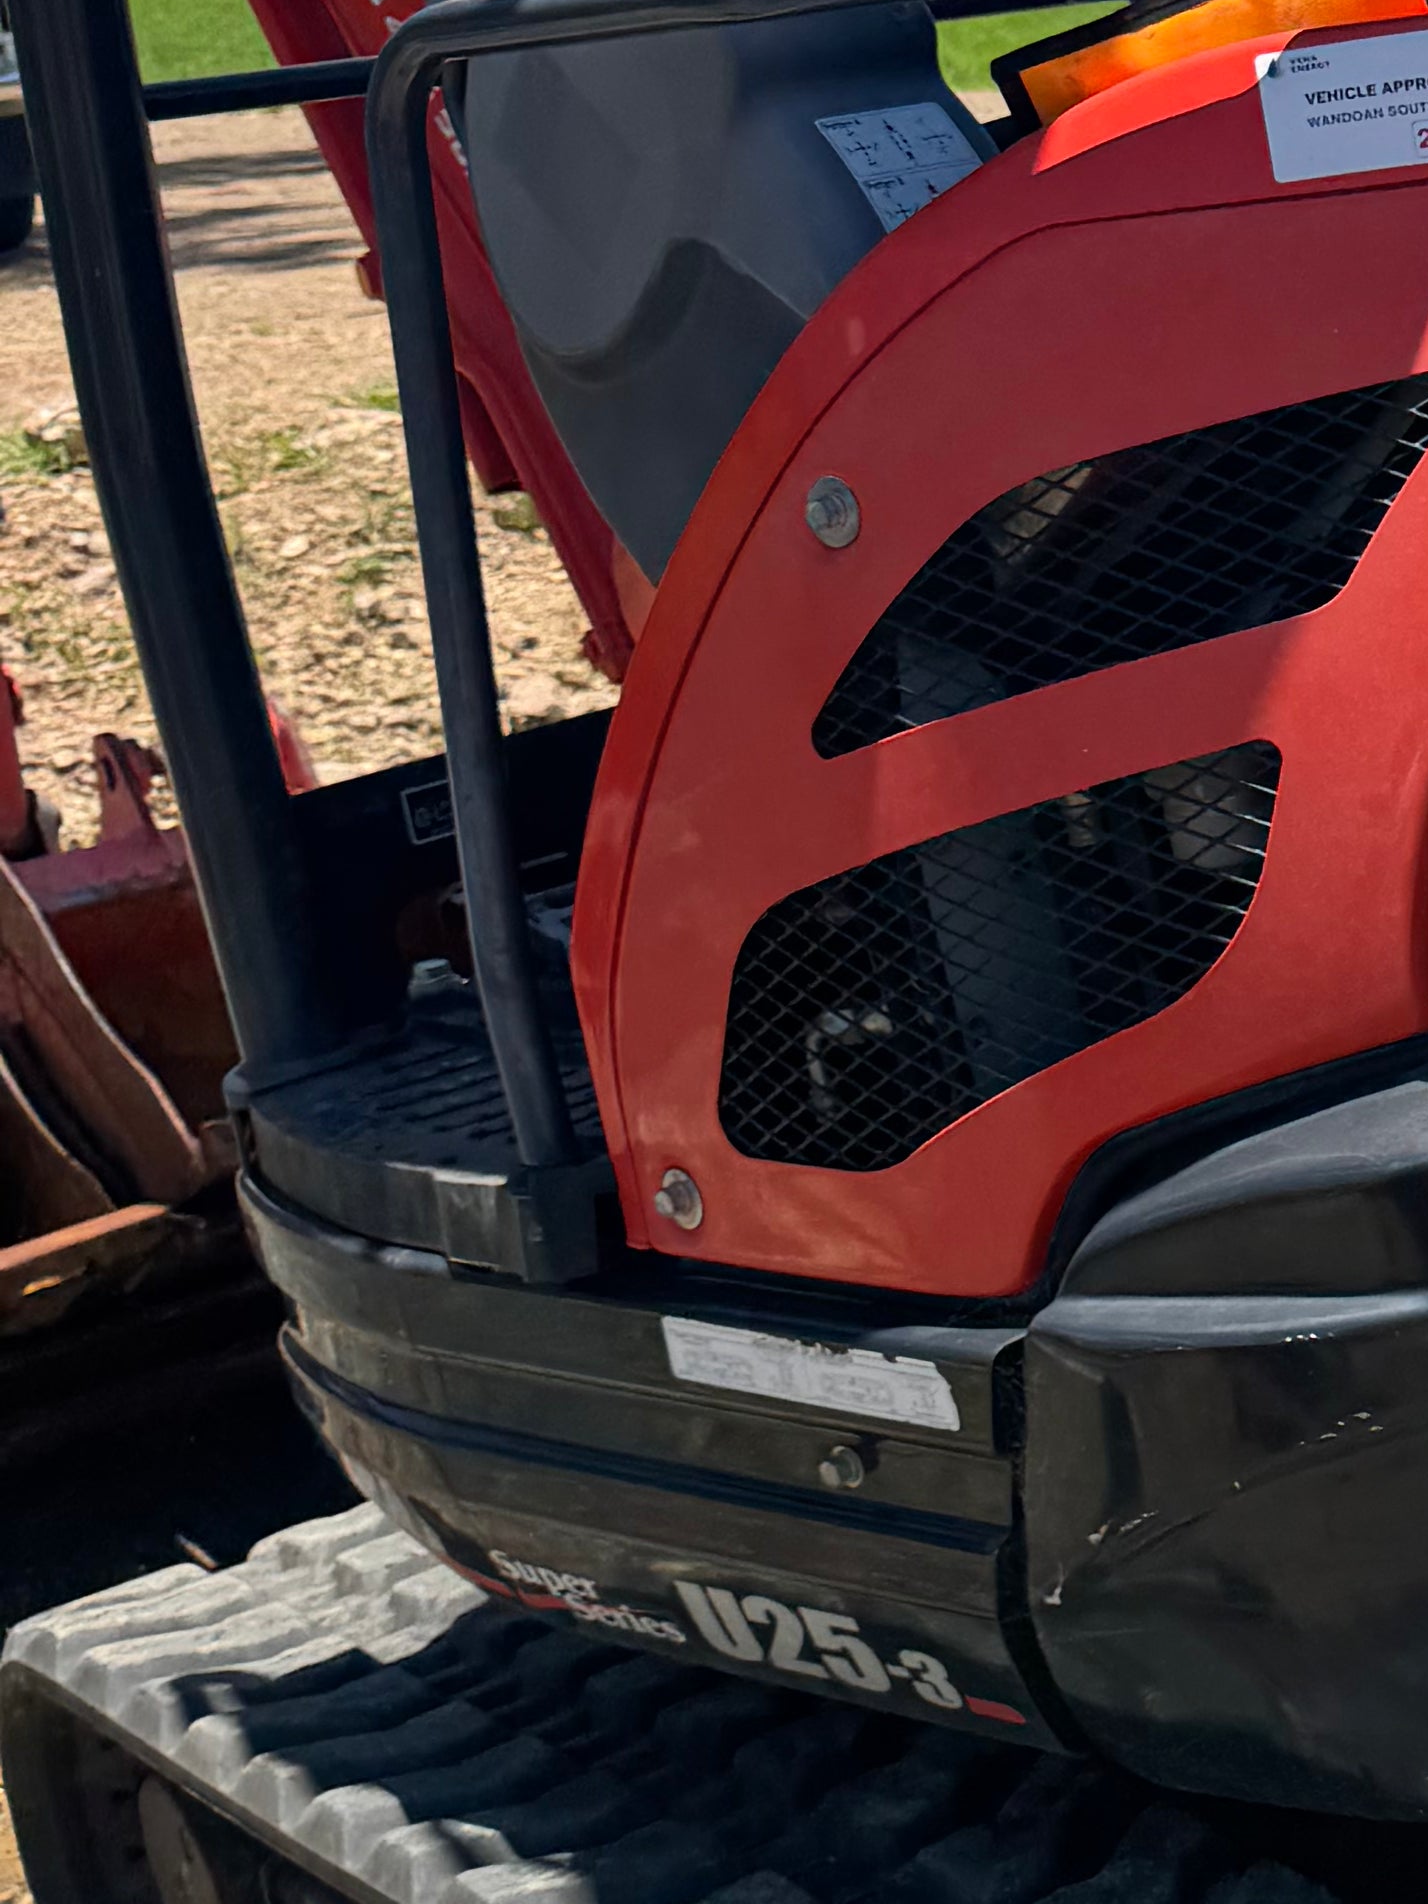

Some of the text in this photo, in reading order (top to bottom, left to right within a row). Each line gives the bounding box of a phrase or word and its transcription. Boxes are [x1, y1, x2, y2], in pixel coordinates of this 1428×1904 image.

[1305, 83, 1377, 106] VEHICLE
[1307, 107, 1385, 129] WANDOAN
[488, 1549, 598, 1600] Super
[562, 1595, 687, 1643] Series
[674, 1581, 964, 1710] U25-3
